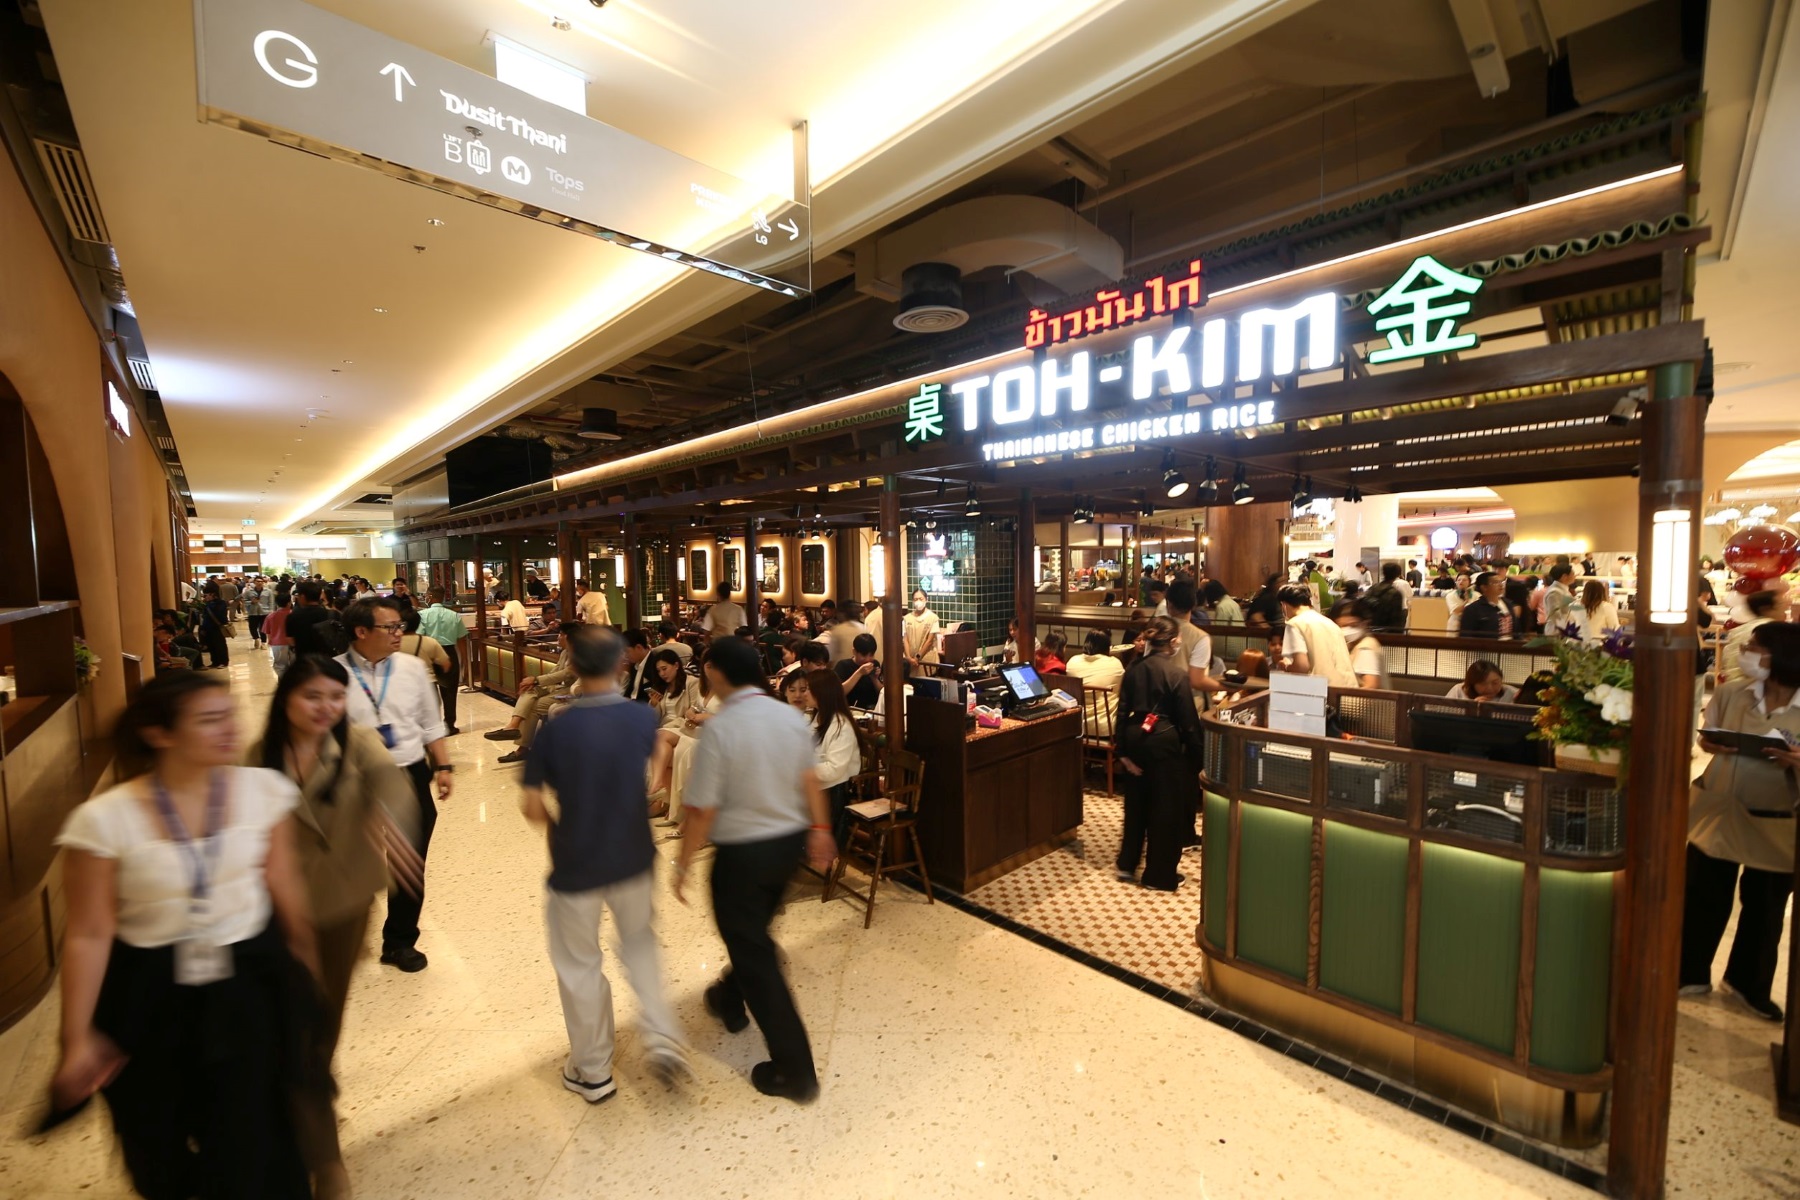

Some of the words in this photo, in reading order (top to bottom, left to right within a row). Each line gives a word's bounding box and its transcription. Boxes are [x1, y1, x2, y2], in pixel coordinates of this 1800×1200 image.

[253, 29, 319, 88] G
[439, 89, 507, 131] Dusit
[506, 115, 567, 155] Thani
[445, 140, 462, 163] B
[545, 166, 584, 191] Tops
[1025, 259, 1201, 349] ข้าวมันไก่
[904, 382, 944, 443] 桌
[1366, 255, 1483, 364] 金
[1101, 411, 1201, 445] CHICKEN
[1211, 400, 1276, 431] RICE
